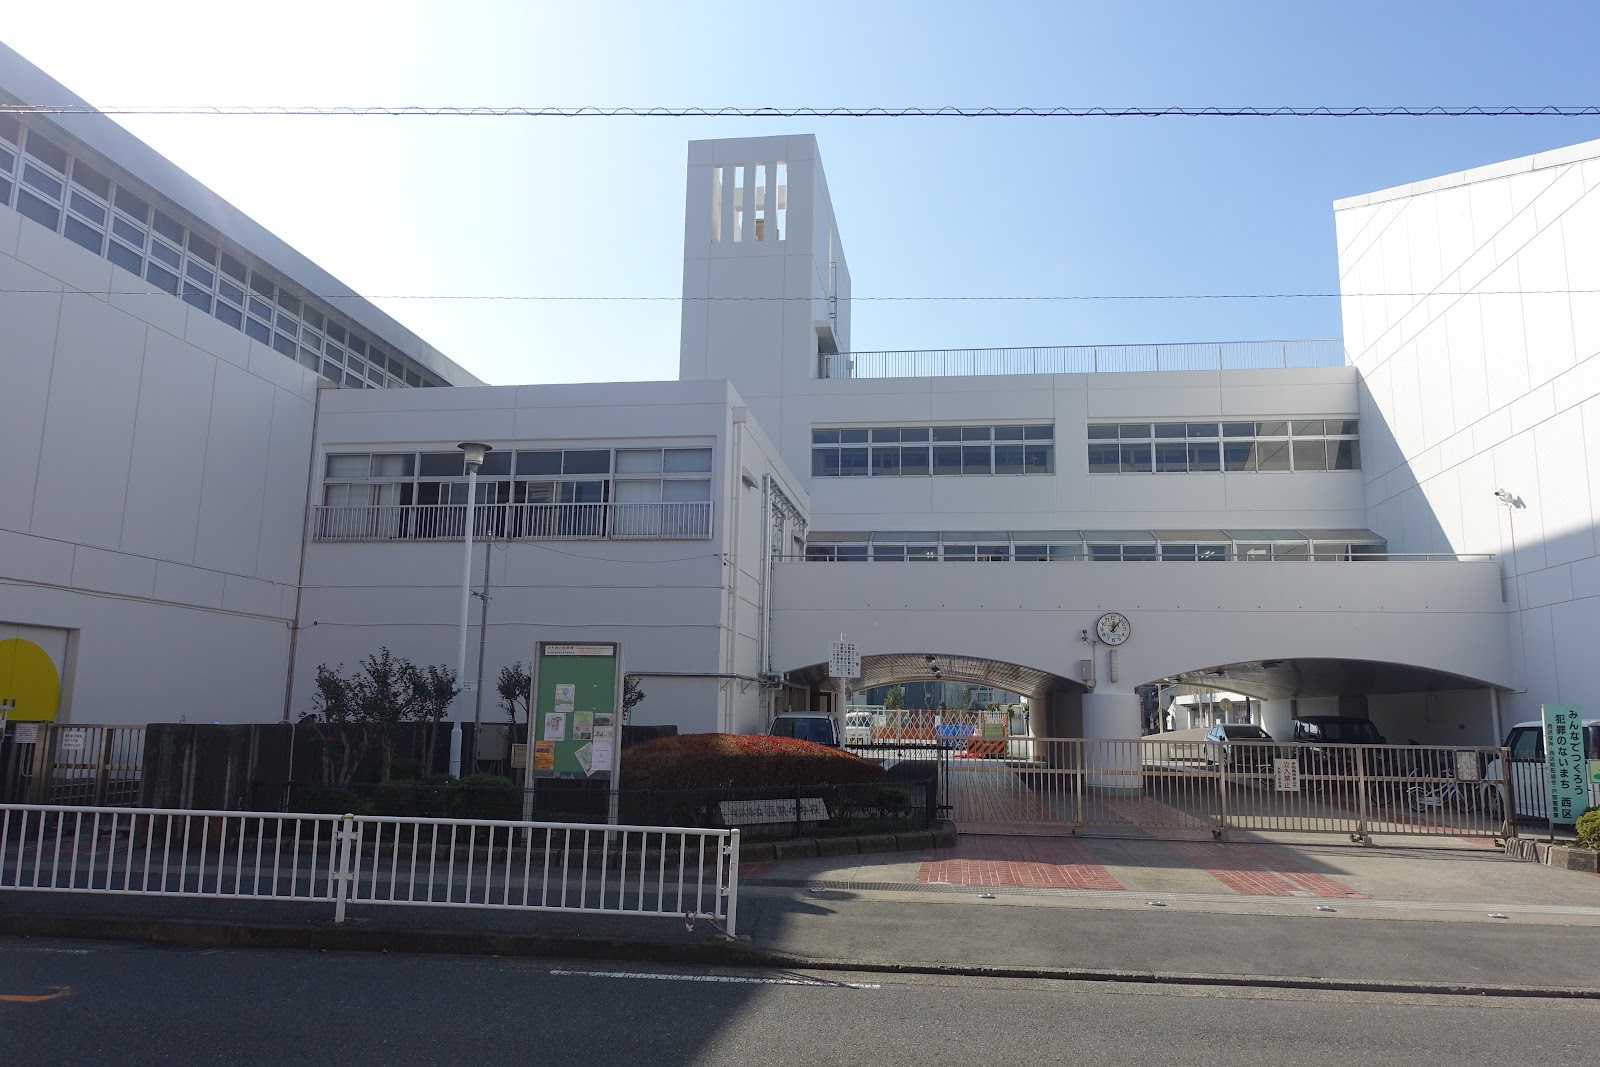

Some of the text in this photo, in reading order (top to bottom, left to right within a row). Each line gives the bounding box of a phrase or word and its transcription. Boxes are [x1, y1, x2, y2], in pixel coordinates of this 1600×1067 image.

[1283, 761, 1292, 789] 立入禁止
[1555, 714, 1573, 819] 犯罪のないまち 西区
[1568, 710, 1584, 795] みんなでつくろう
